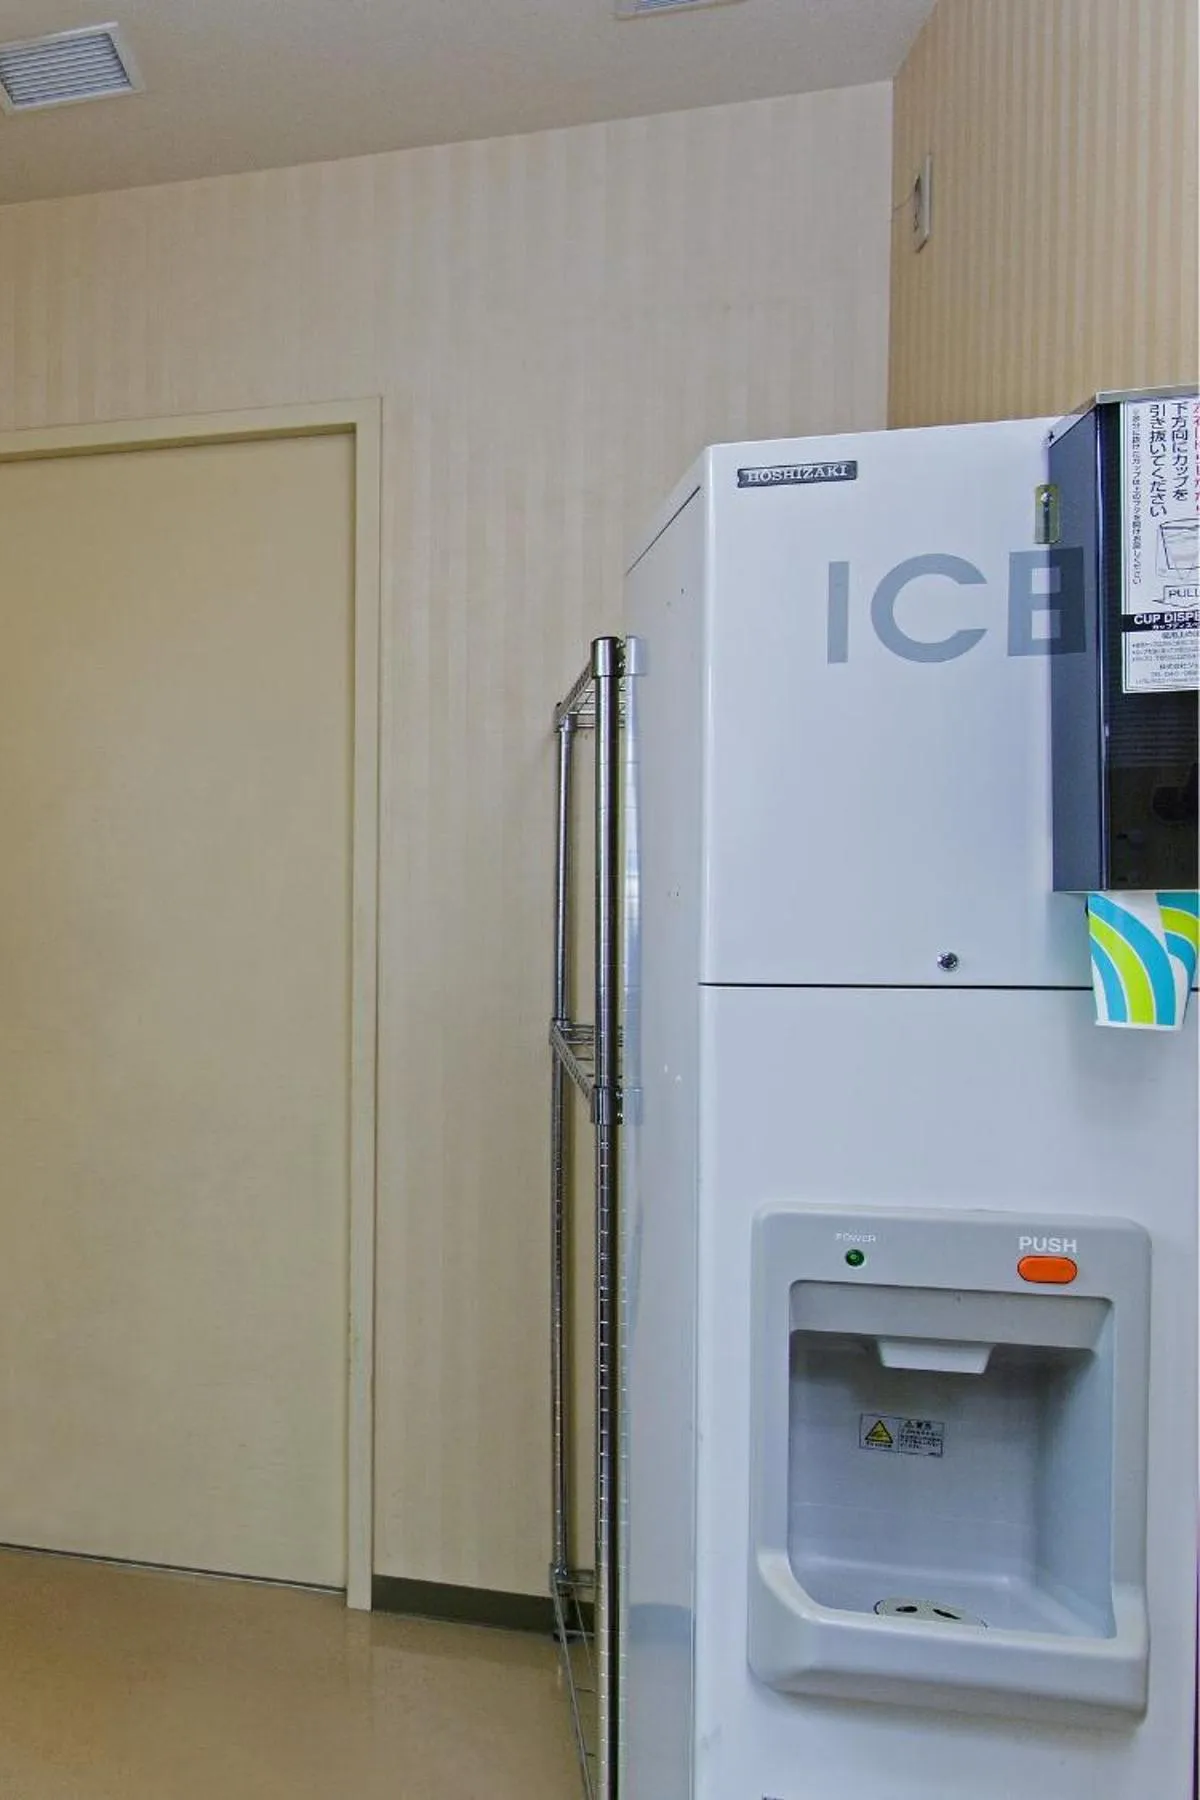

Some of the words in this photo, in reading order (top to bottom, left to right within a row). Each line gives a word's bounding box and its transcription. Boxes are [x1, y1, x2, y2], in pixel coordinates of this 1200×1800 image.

[747, 464, 848, 484] HOSHIZAKI
[1149, 403, 1167, 518] 引き抜いてください
[1171, 401, 1189, 502] 下方向にカップを
[827, 546, 1086, 664] ICE
[1133, 613, 1161, 624] CUP
[1018, 1235, 1078, 1254] PUSH
